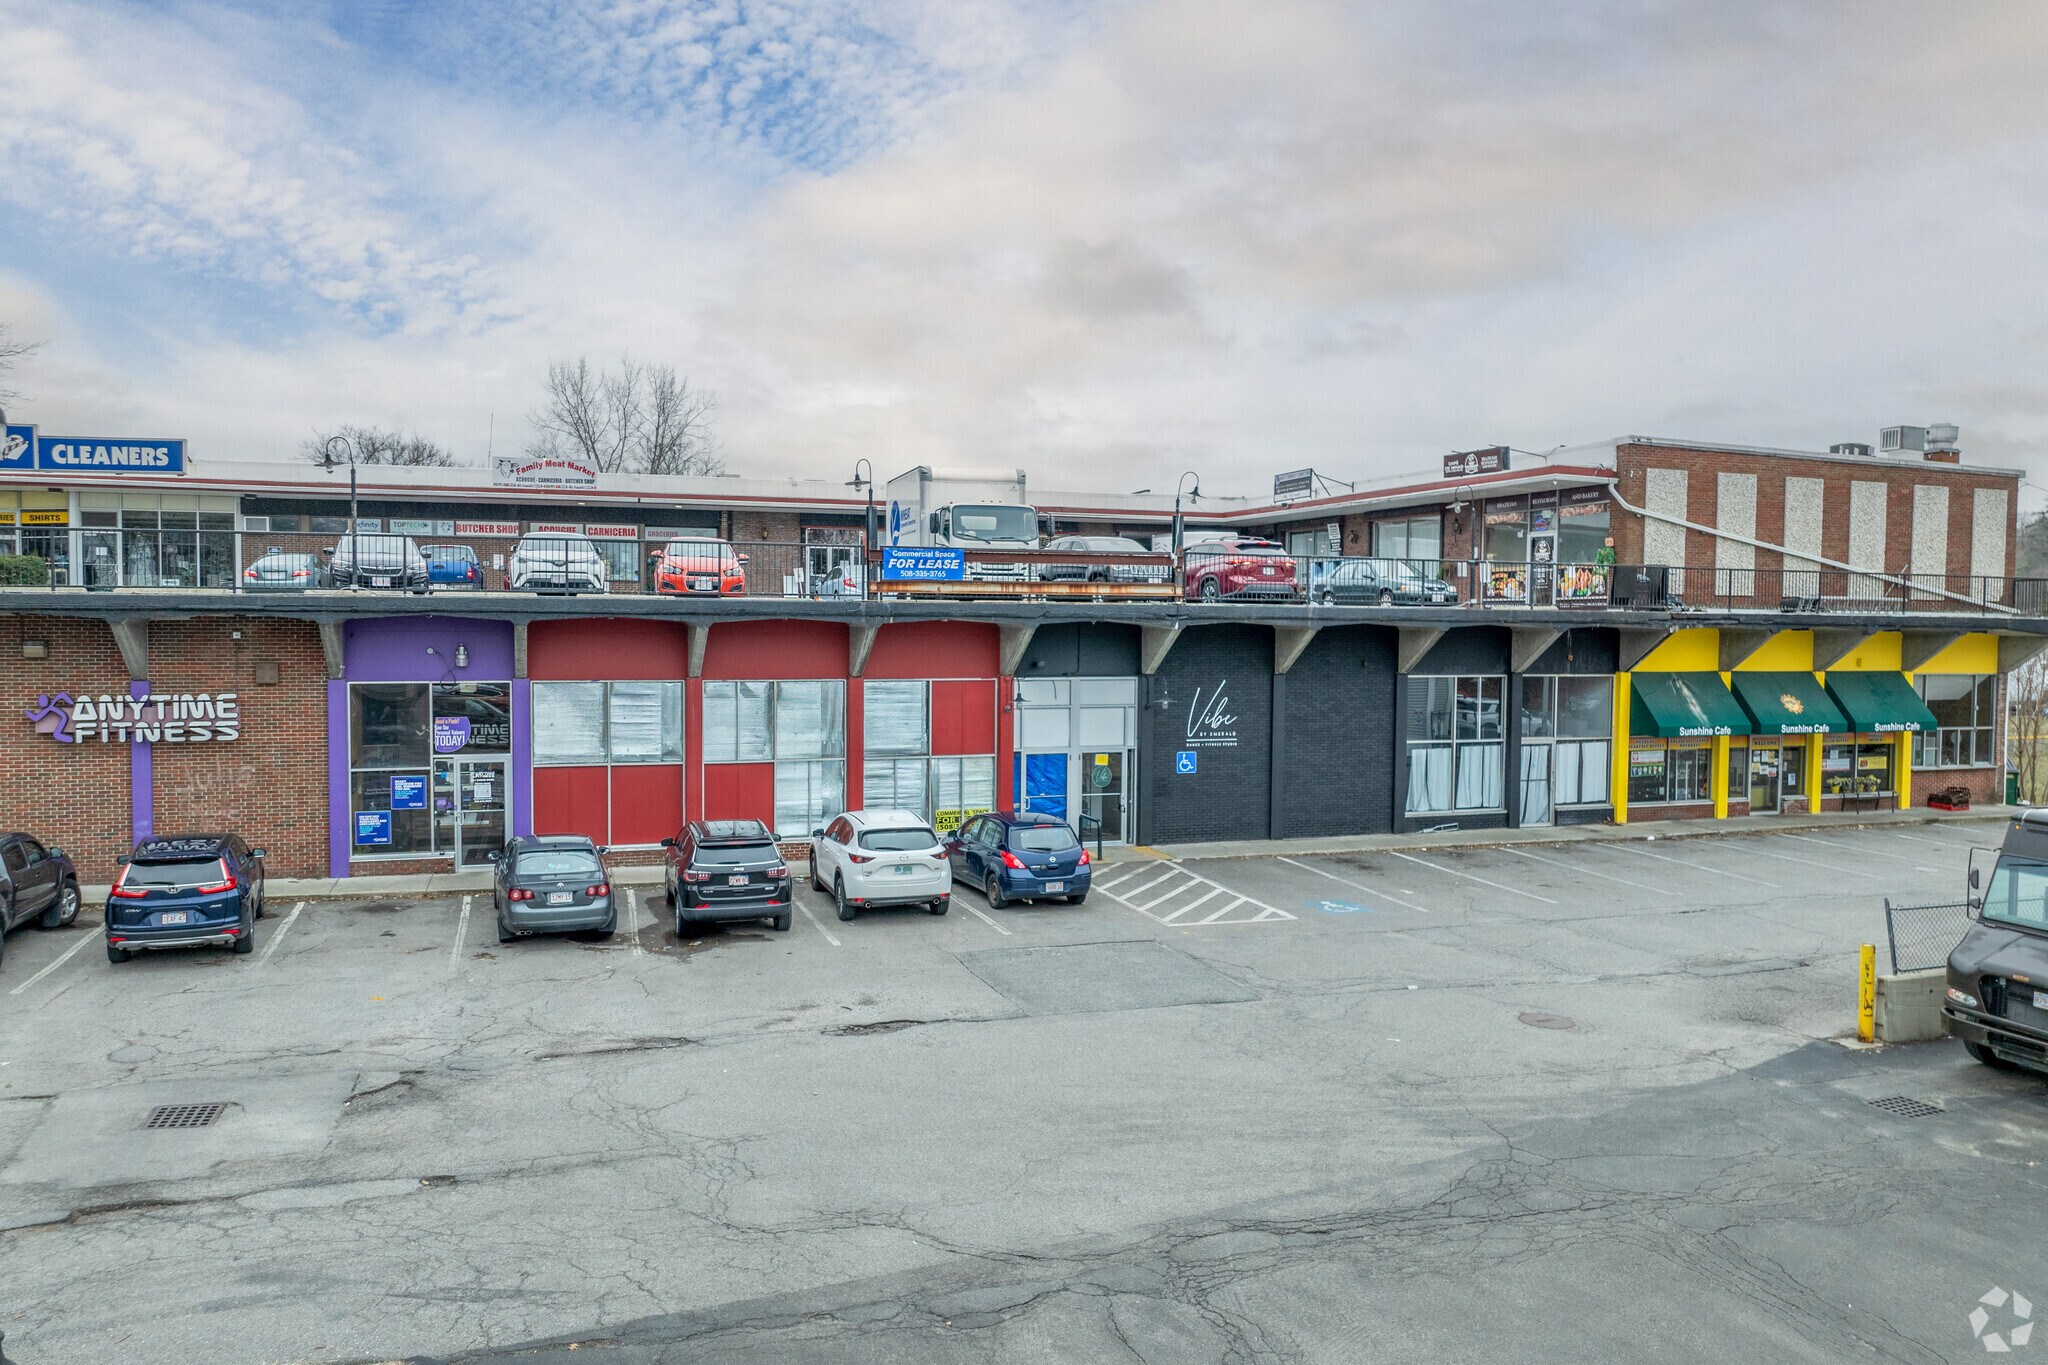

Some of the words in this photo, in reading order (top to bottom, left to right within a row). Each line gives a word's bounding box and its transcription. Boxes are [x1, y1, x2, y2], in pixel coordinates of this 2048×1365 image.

[52, 444, 169, 466] CLEANERS
[515, 461, 542, 476] Family
[545, 460, 565, 468] Meat
[567, 461, 596, 479] Market
[1582, 491, 1599, 499] BAKERY
[29, 514, 61, 522] SHIRTS
[456, 524, 495, 533] BUTCHER
[496, 525, 519, 534] SHOP
[587, 527, 636, 537] CARNICERIA
[647, 530, 679, 538] GROCERIES
[892, 549, 934, 558] Commercial
[934, 550, 956, 559] Space
[888, 559, 915, 569] FOR
[917, 559, 960, 569] LEASE
[900, 570, 947, 578] 508-335-3765
[72, 694, 238, 721] ANYTIME
[1187, 680, 1238, 737] Vibe
[471, 723, 509, 735] TIME
[1679, 726, 1714, 736] Sunshine
[1714, 726, 1732, 735] Cafe
[1781, 724, 1813, 733] Sunshine
[1814, 724, 1830, 733] Cafe
[1874, 722, 1905, 732] Sunshine
[1905, 722, 1920, 731] Cafe
[75, 721, 240, 744] FITNESS
[435, 735, 465, 746] TODAY!
[936, 816, 956, 824] FOR
